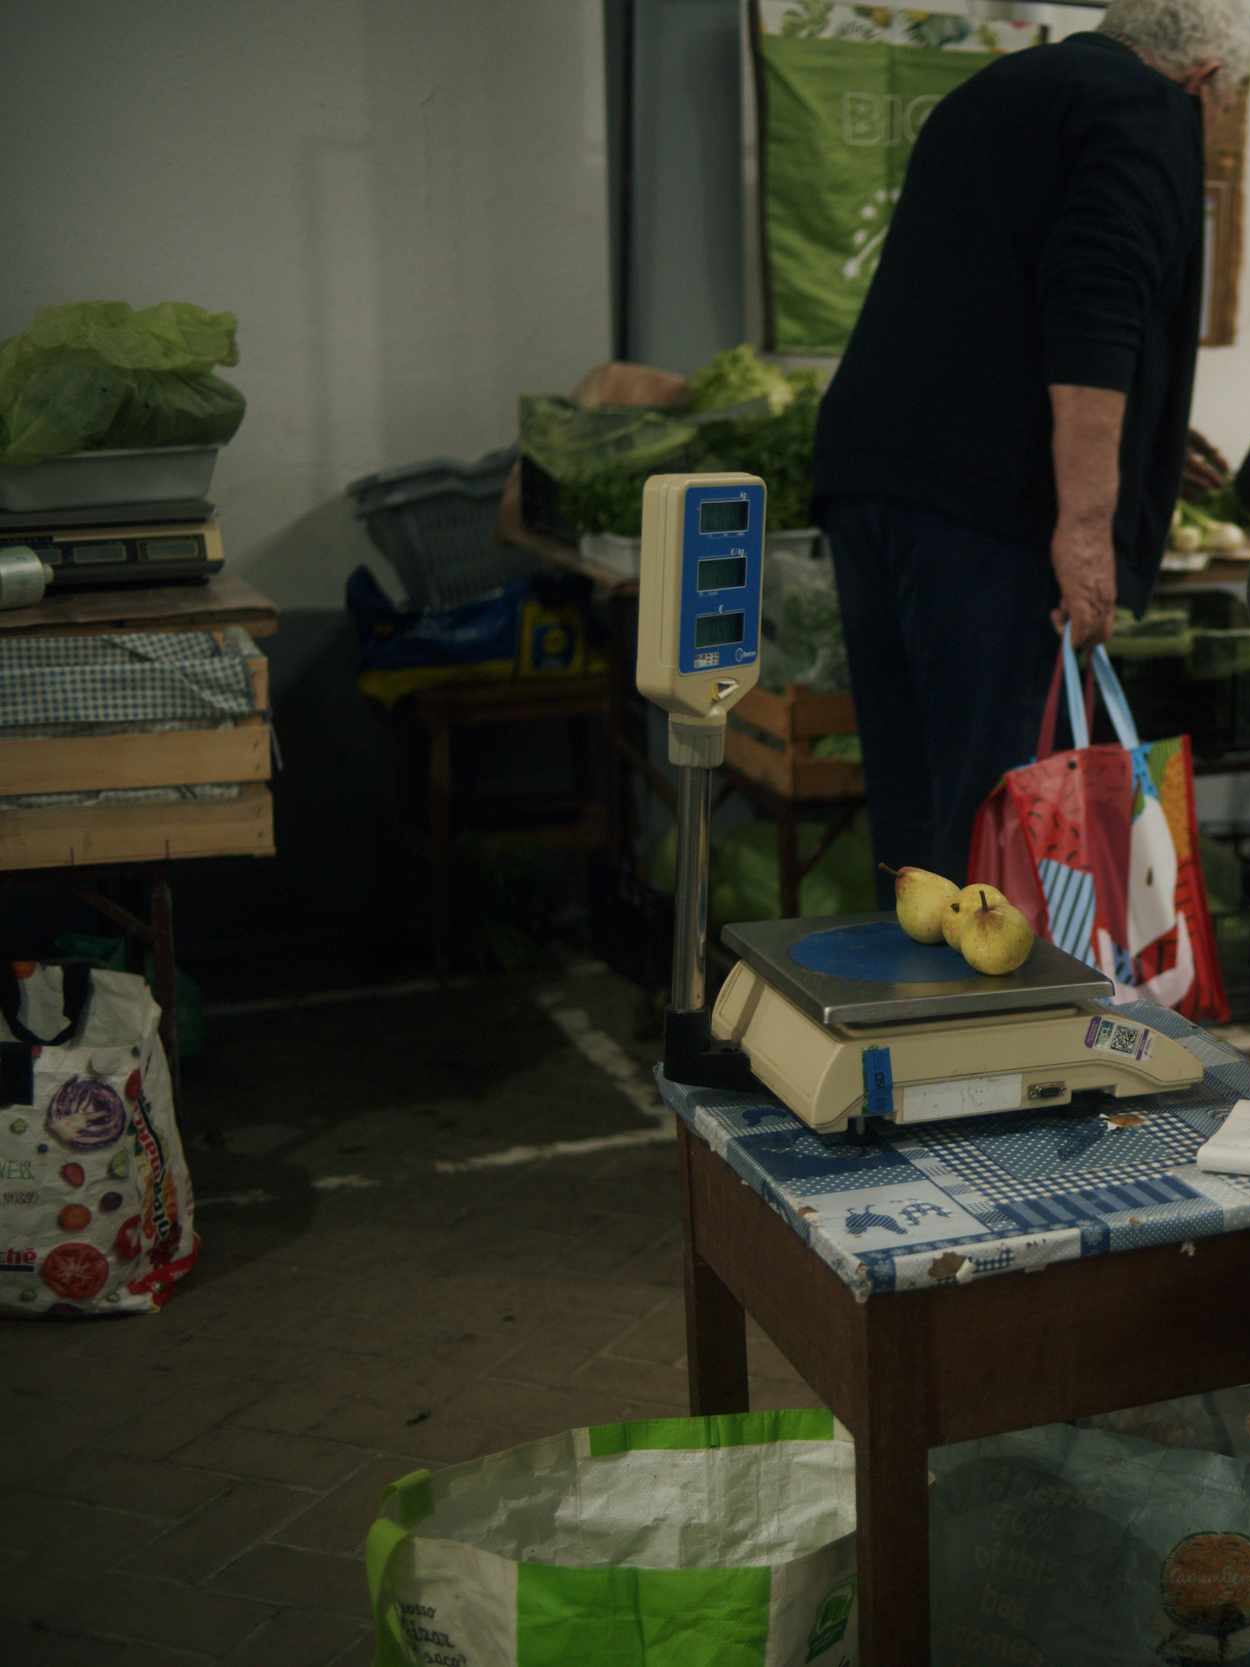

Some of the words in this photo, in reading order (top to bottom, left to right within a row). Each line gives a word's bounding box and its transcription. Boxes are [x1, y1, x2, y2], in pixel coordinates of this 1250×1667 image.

[990, 1501, 1061, 1542] 50%
[974, 1540, 1002, 1572] of
[1005, 1544, 1064, 1585] this
[979, 1582, 1031, 1632] bag
